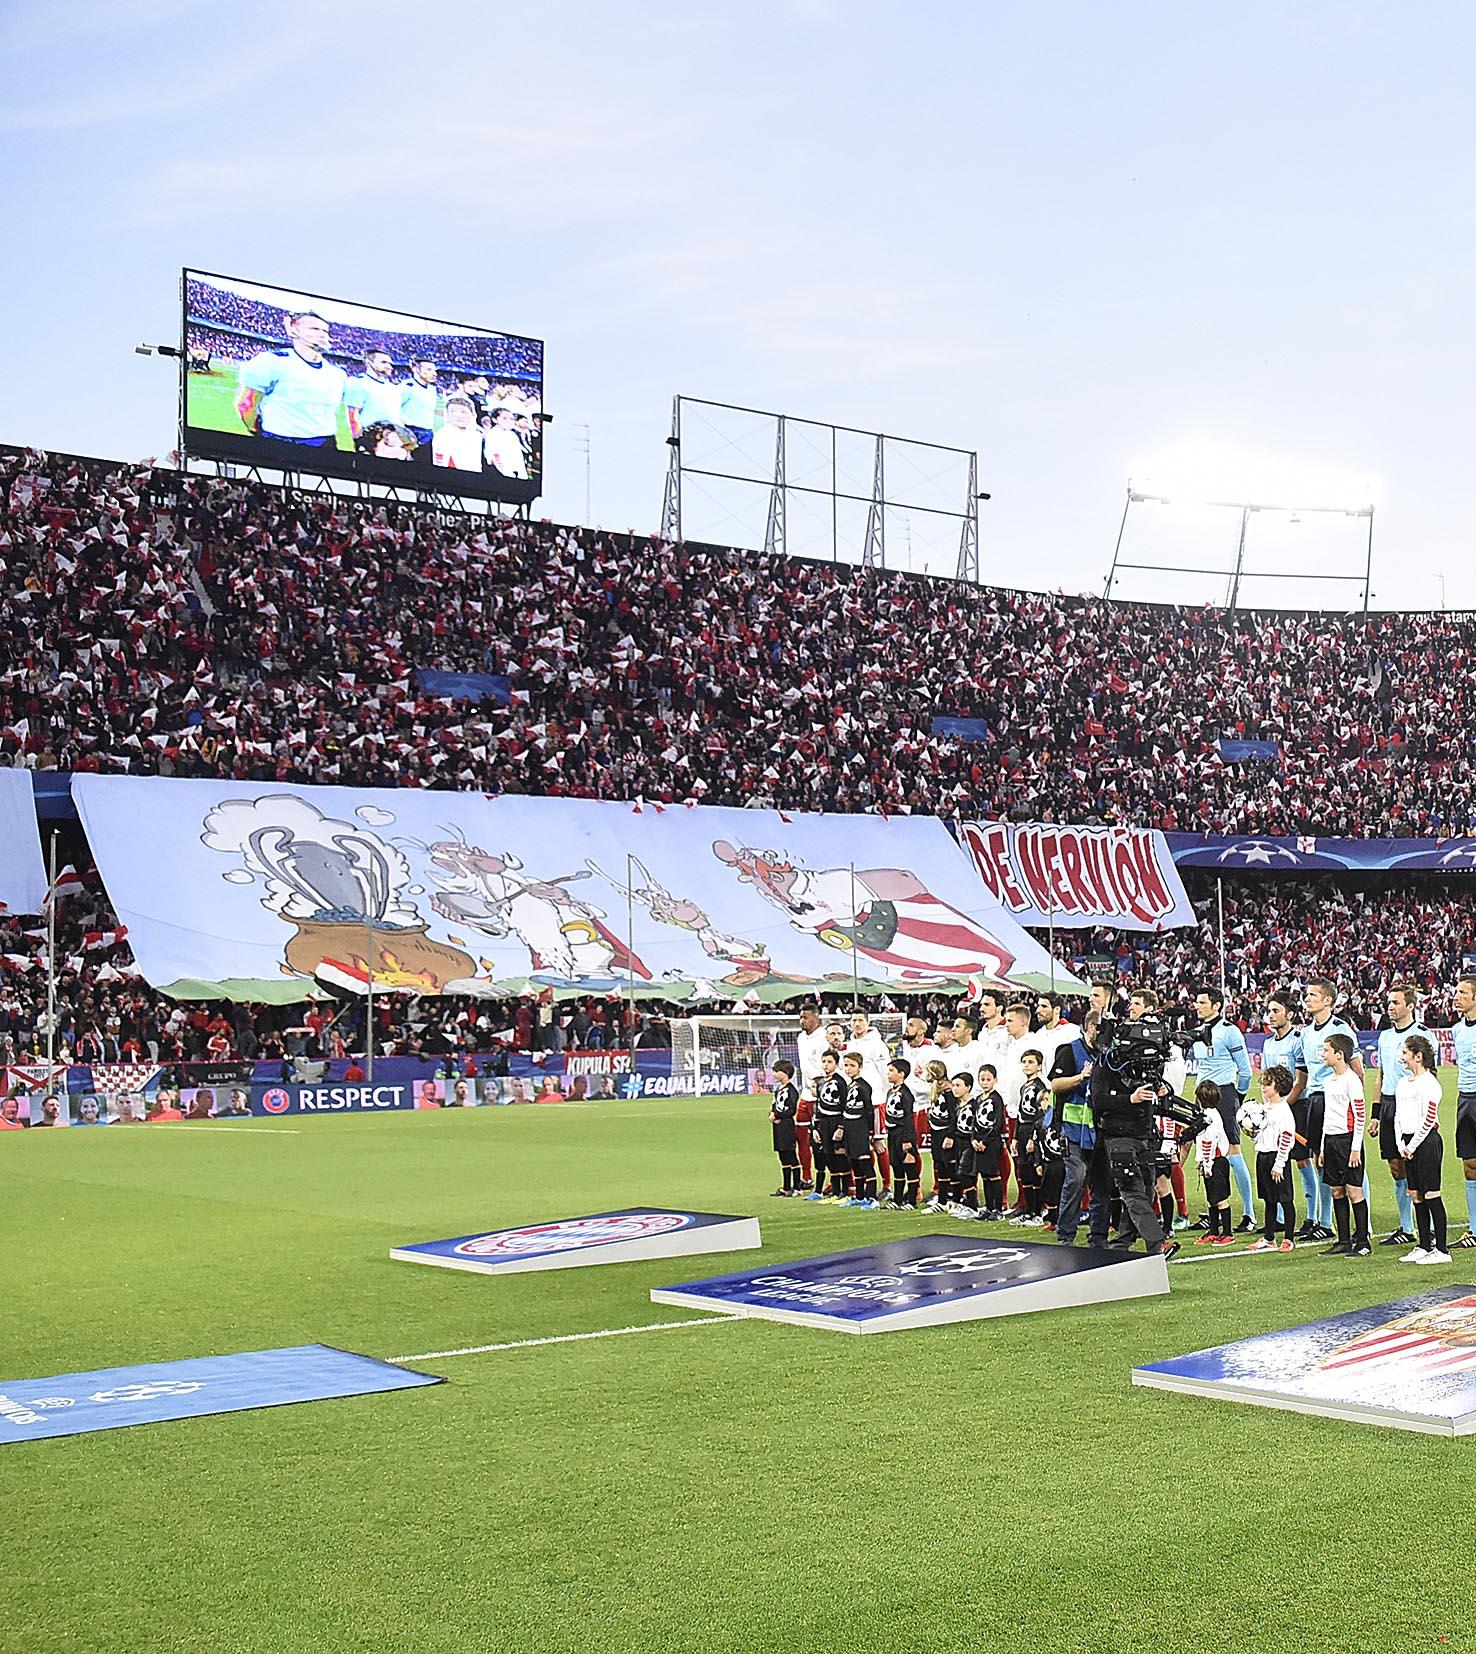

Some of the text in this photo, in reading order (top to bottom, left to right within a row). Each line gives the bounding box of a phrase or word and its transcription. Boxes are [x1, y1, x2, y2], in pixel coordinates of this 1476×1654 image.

[567, 1056, 610, 1075] KUPULA
[300, 1086, 405, 1110] RESPECT
[750, 1275, 921, 1305] CHAMPIONS
